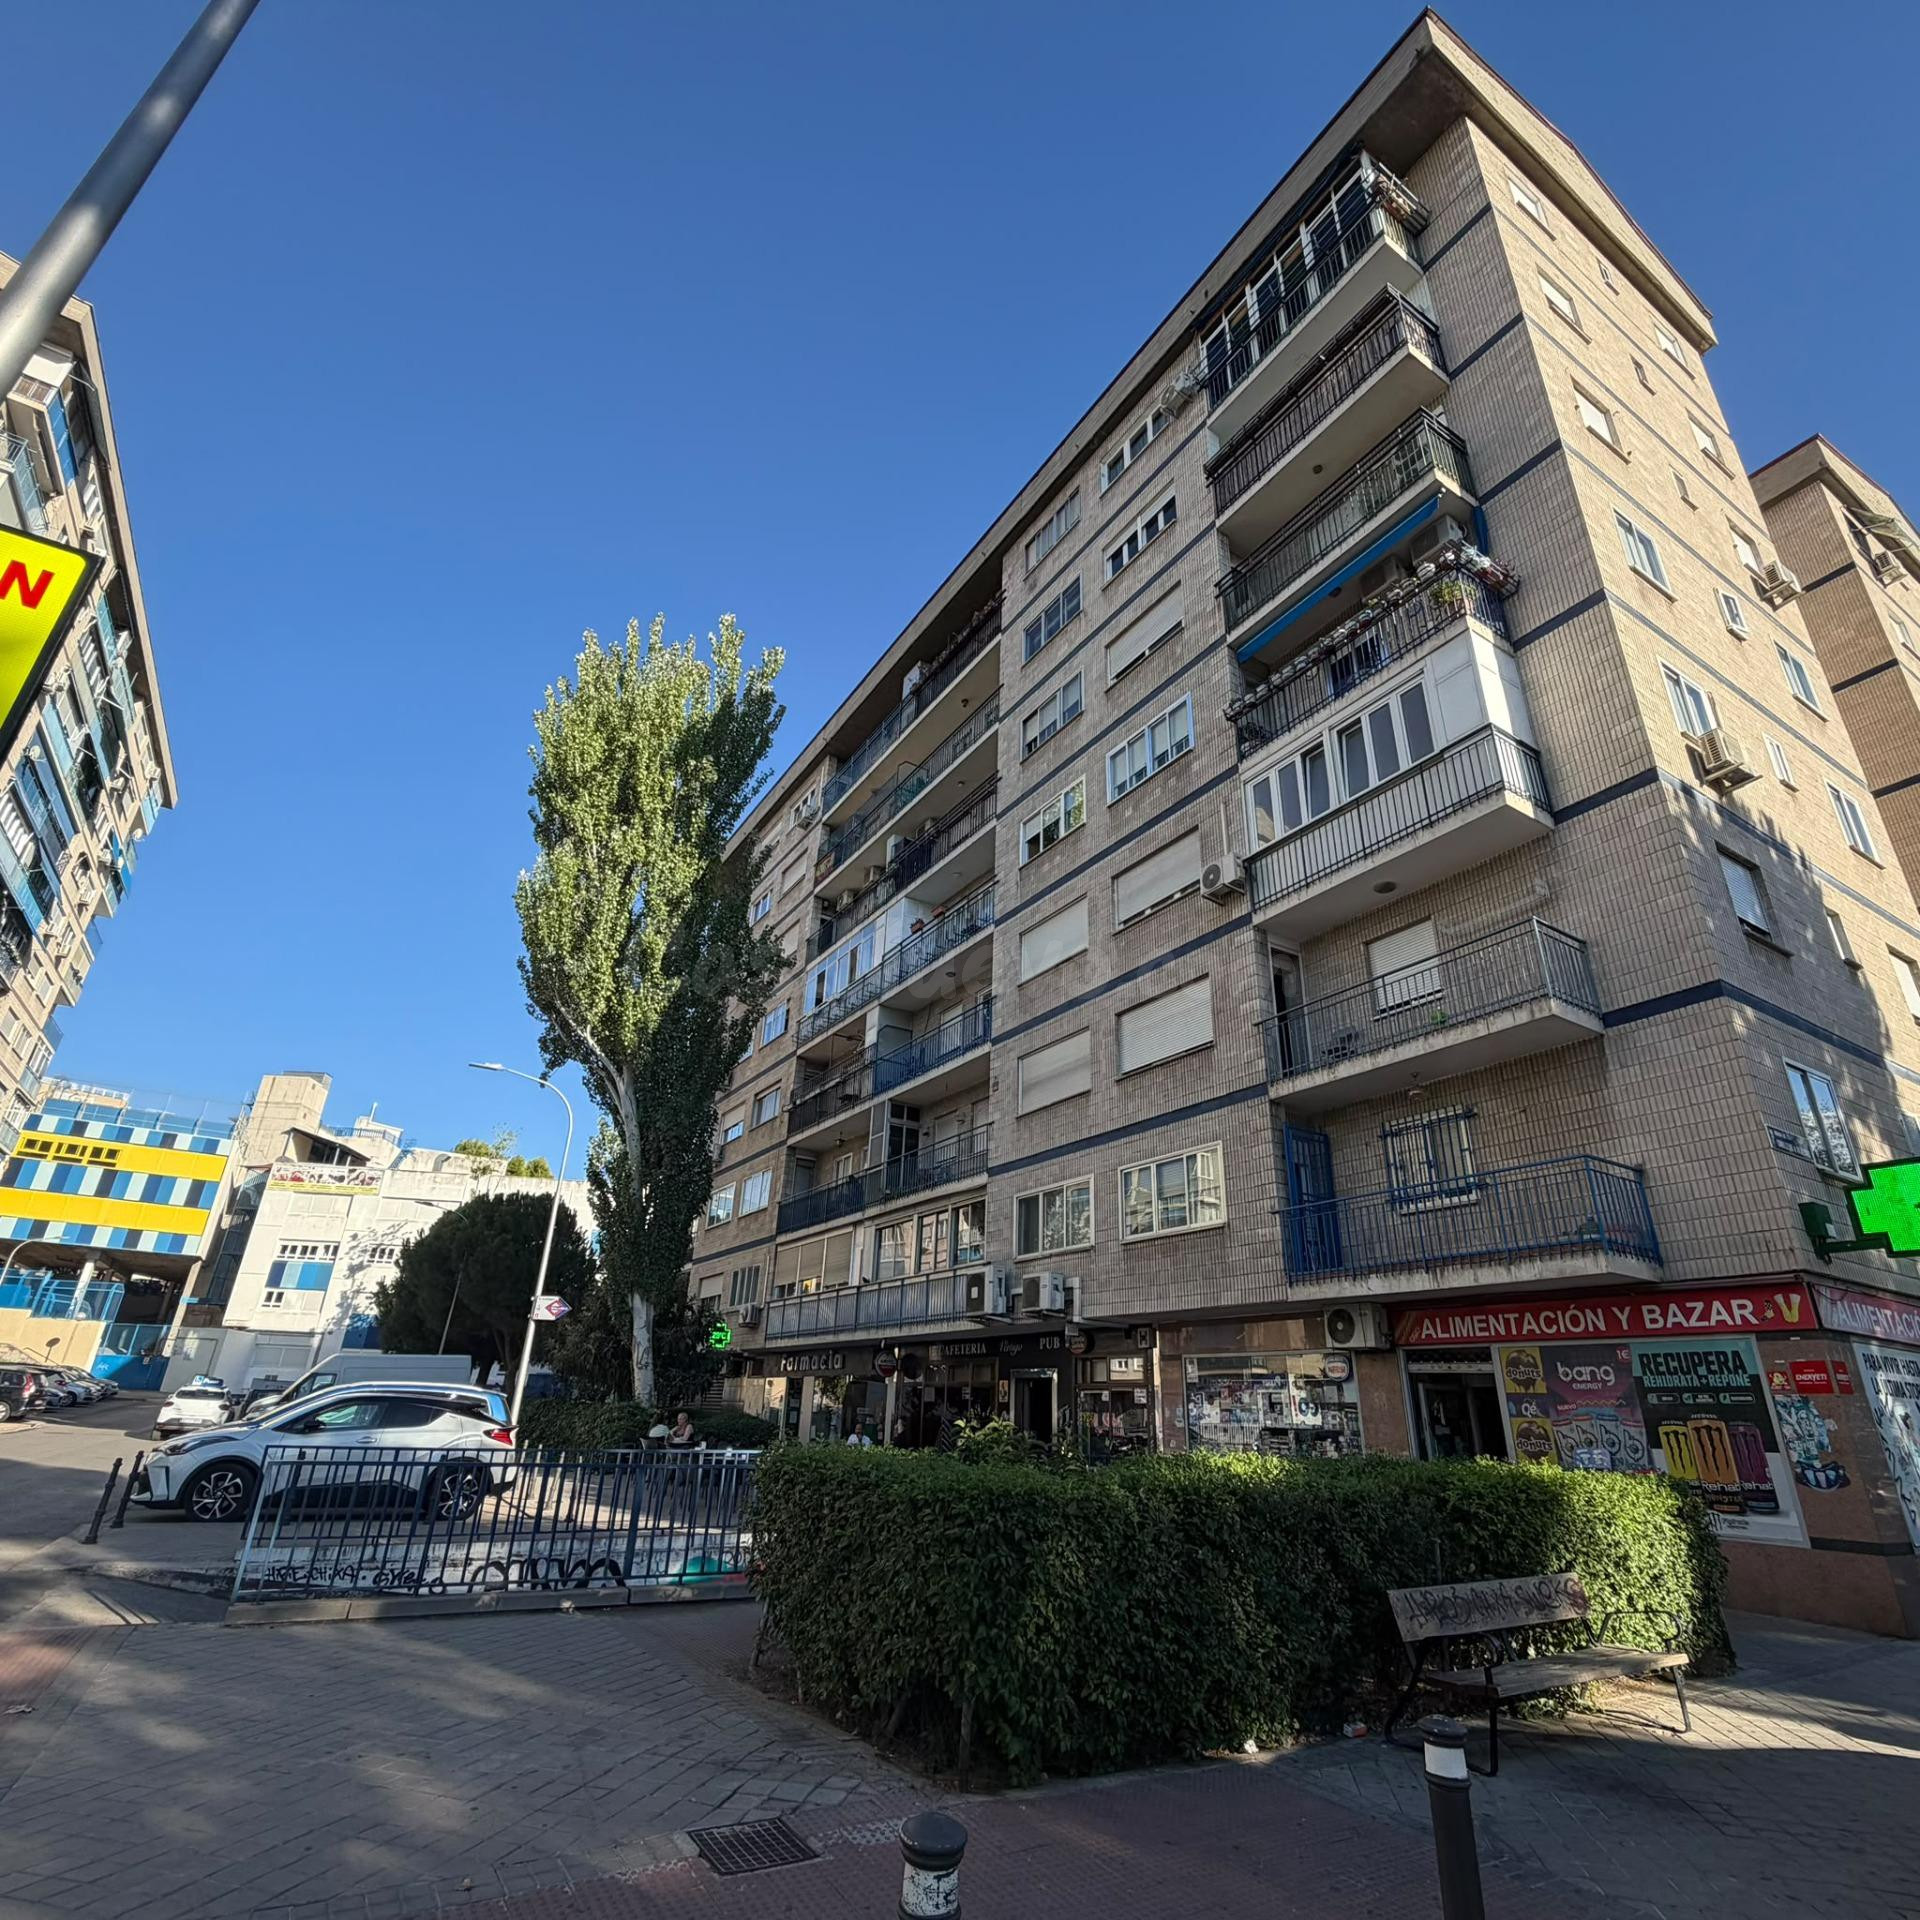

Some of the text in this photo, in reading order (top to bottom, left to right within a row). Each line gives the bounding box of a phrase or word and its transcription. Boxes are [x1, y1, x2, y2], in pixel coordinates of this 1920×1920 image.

[1420, 1299, 1760, 1340] ALIMENTACIÓN Y BAZAR
[1039, 1336, 1060, 1350] PUB
[1638, 1350, 1749, 1376] RECUPERA
[1505, 1366, 1542, 1380] donuts
[1556, 1360, 1616, 1386] bang
[1572, 1381, 1603, 1391] ENERGY
[1516, 1439, 1553, 1452] donuts
